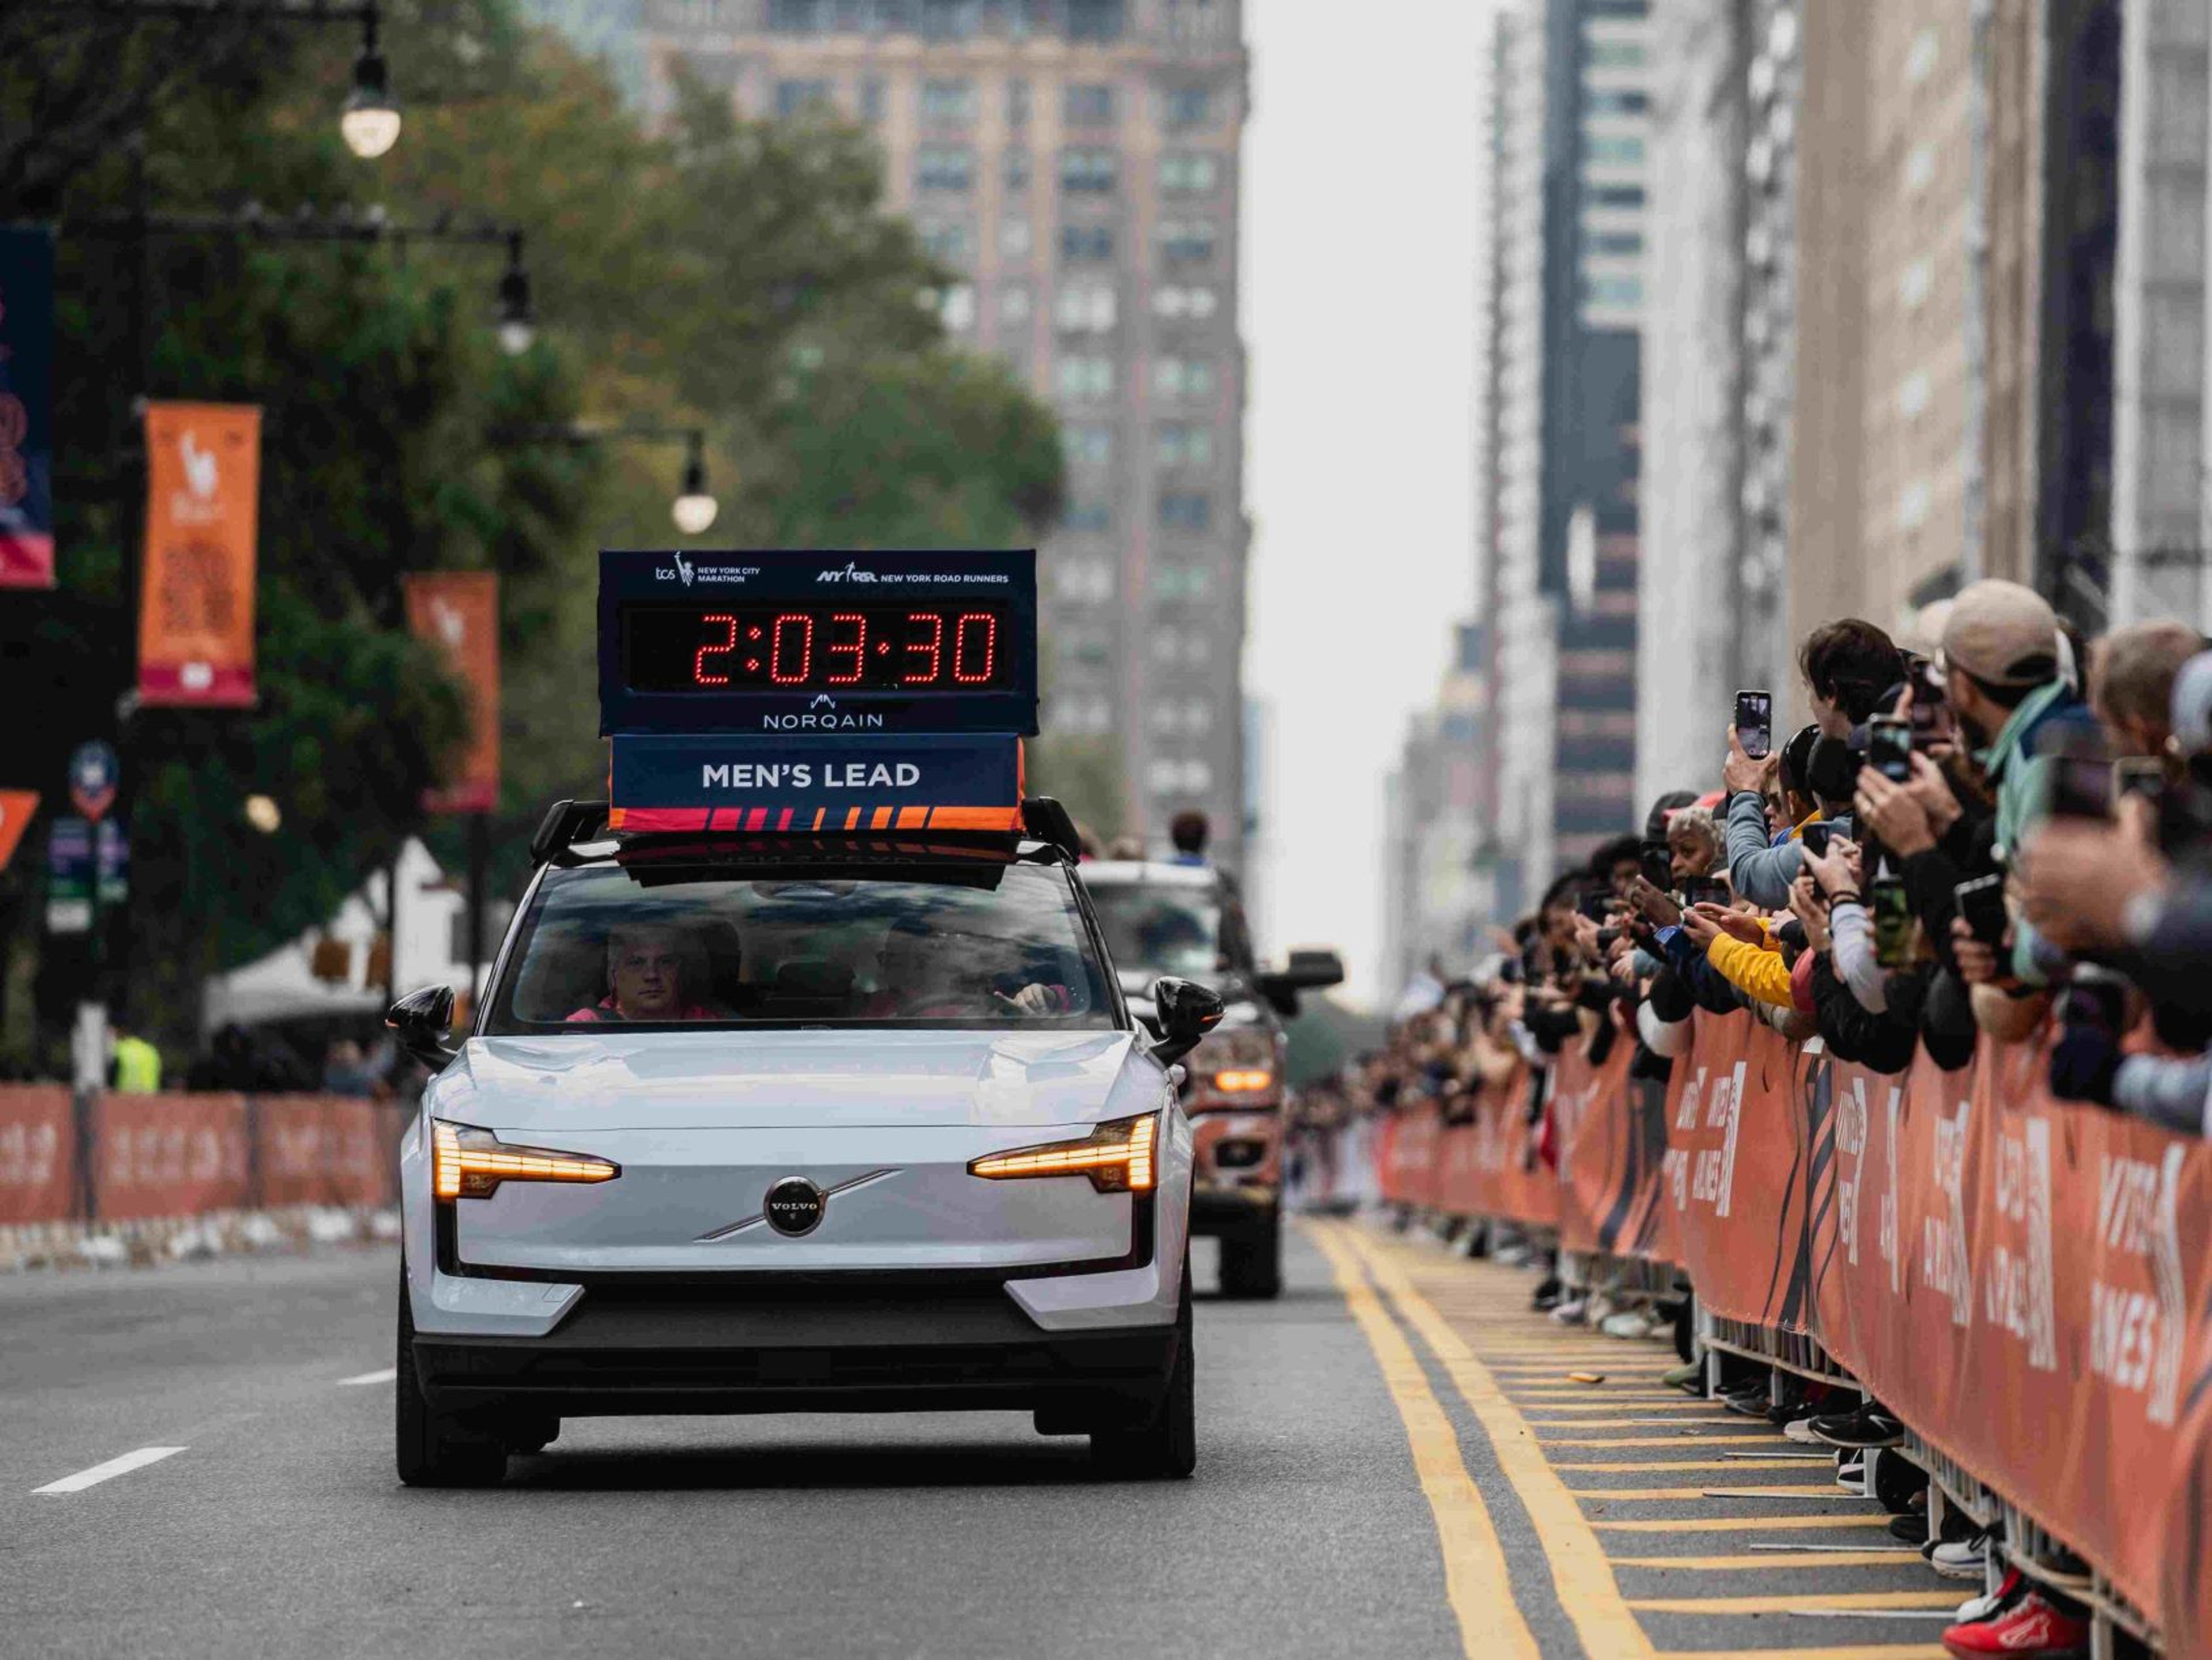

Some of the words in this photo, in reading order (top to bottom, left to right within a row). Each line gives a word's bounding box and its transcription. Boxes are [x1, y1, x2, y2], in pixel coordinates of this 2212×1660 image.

[656, 567, 676, 580] tcs
[881, 574, 904, 583] NEW
[906, 574, 931, 583] YORK
[933, 574, 961, 583] ROAD
[963, 575, 1009, 583] RUNNERS
[764, 714, 882, 729] NORQAIN
[702, 763, 812, 788] MEN'S
[824, 763, 920, 788] LEAD
